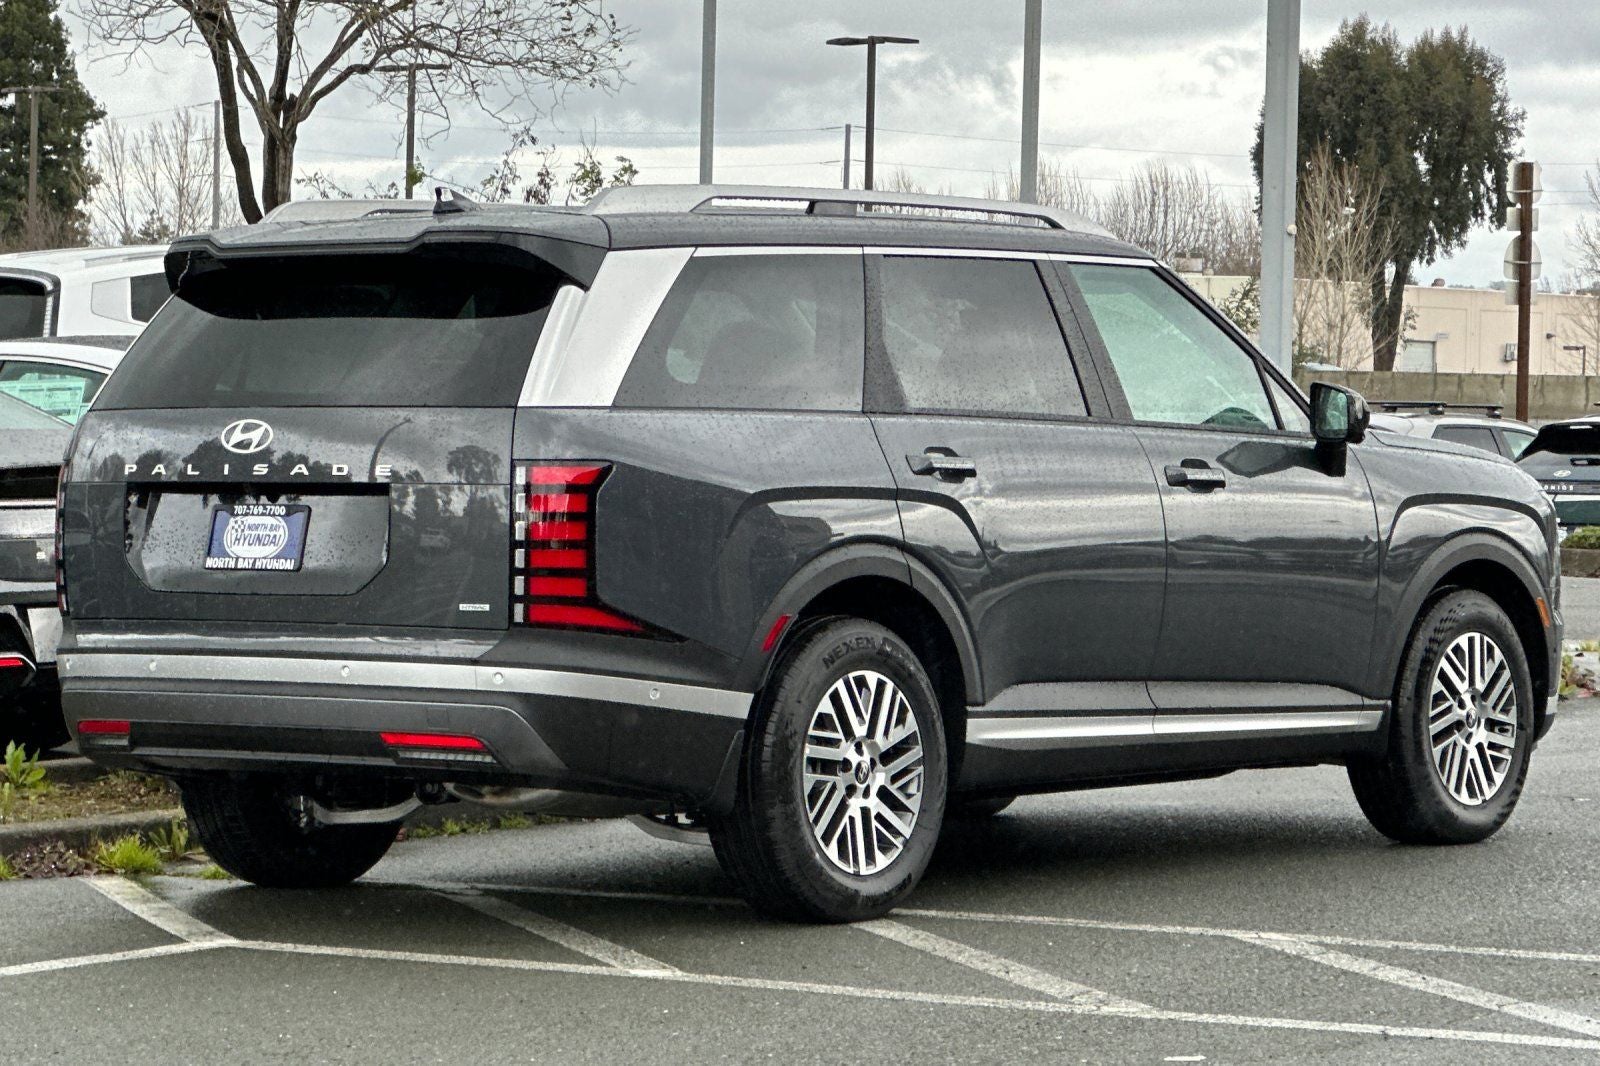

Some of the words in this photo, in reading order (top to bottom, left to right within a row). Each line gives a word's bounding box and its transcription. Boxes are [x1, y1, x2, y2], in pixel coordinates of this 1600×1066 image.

[124, 463, 393, 476] PALISADE
[233, 505, 286, 516] 707-769-7700
[246, 523, 269, 532] NORTH
[269, 524, 281, 532] BAY
[233, 533, 282, 547] HYUNDAI
[205, 557, 236, 569] NORTH
[238, 558, 255, 569] BAY
[256, 558, 295, 570] HYUNDAI
[822, 637, 875, 669] NEXEN
